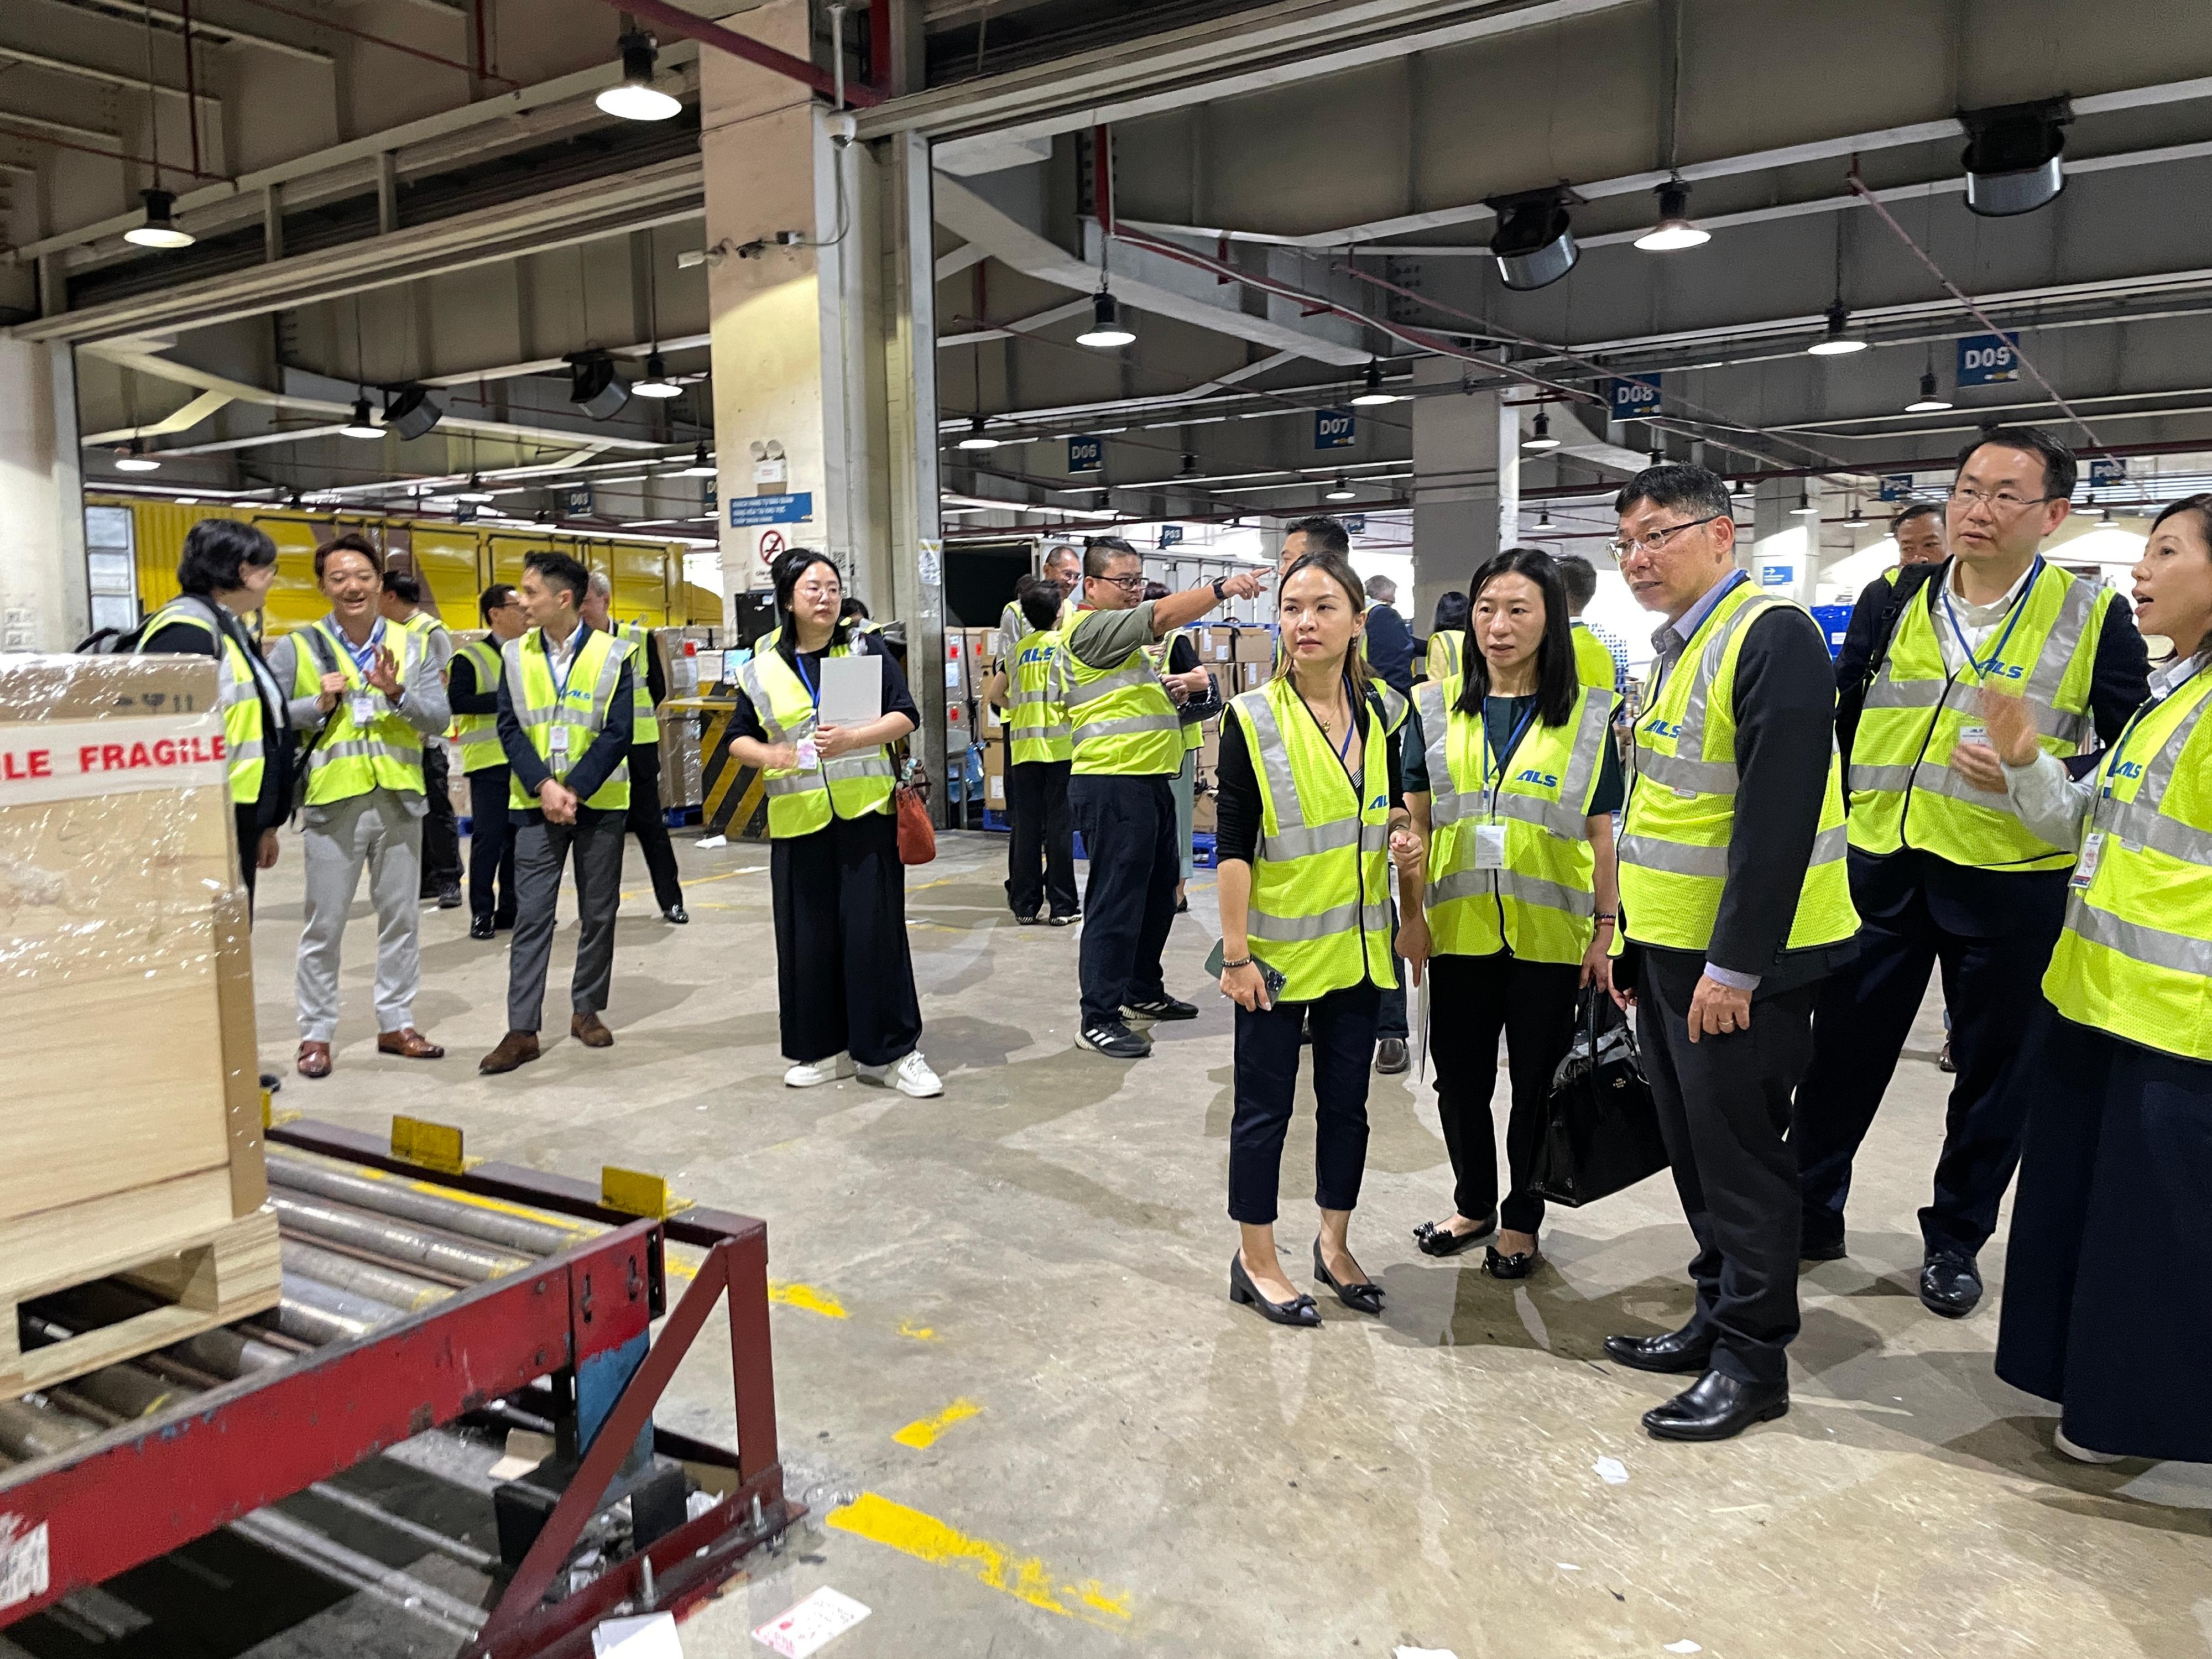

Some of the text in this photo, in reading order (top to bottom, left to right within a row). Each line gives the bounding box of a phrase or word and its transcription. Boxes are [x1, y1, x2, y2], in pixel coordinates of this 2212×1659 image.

[1618, 385, 1654, 404] D08
[1319, 418, 1349, 435] D07
[1071, 444, 1097, 460] D06
[1018, 647, 1056, 667] ALS
[1978, 659, 2025, 680] ALS
[1642, 719, 1682, 739] ALS
[79, 734, 227, 774] FRAGILE
[1516, 770, 1558, 788] ALS
[2115, 761, 2143, 779] ALS
